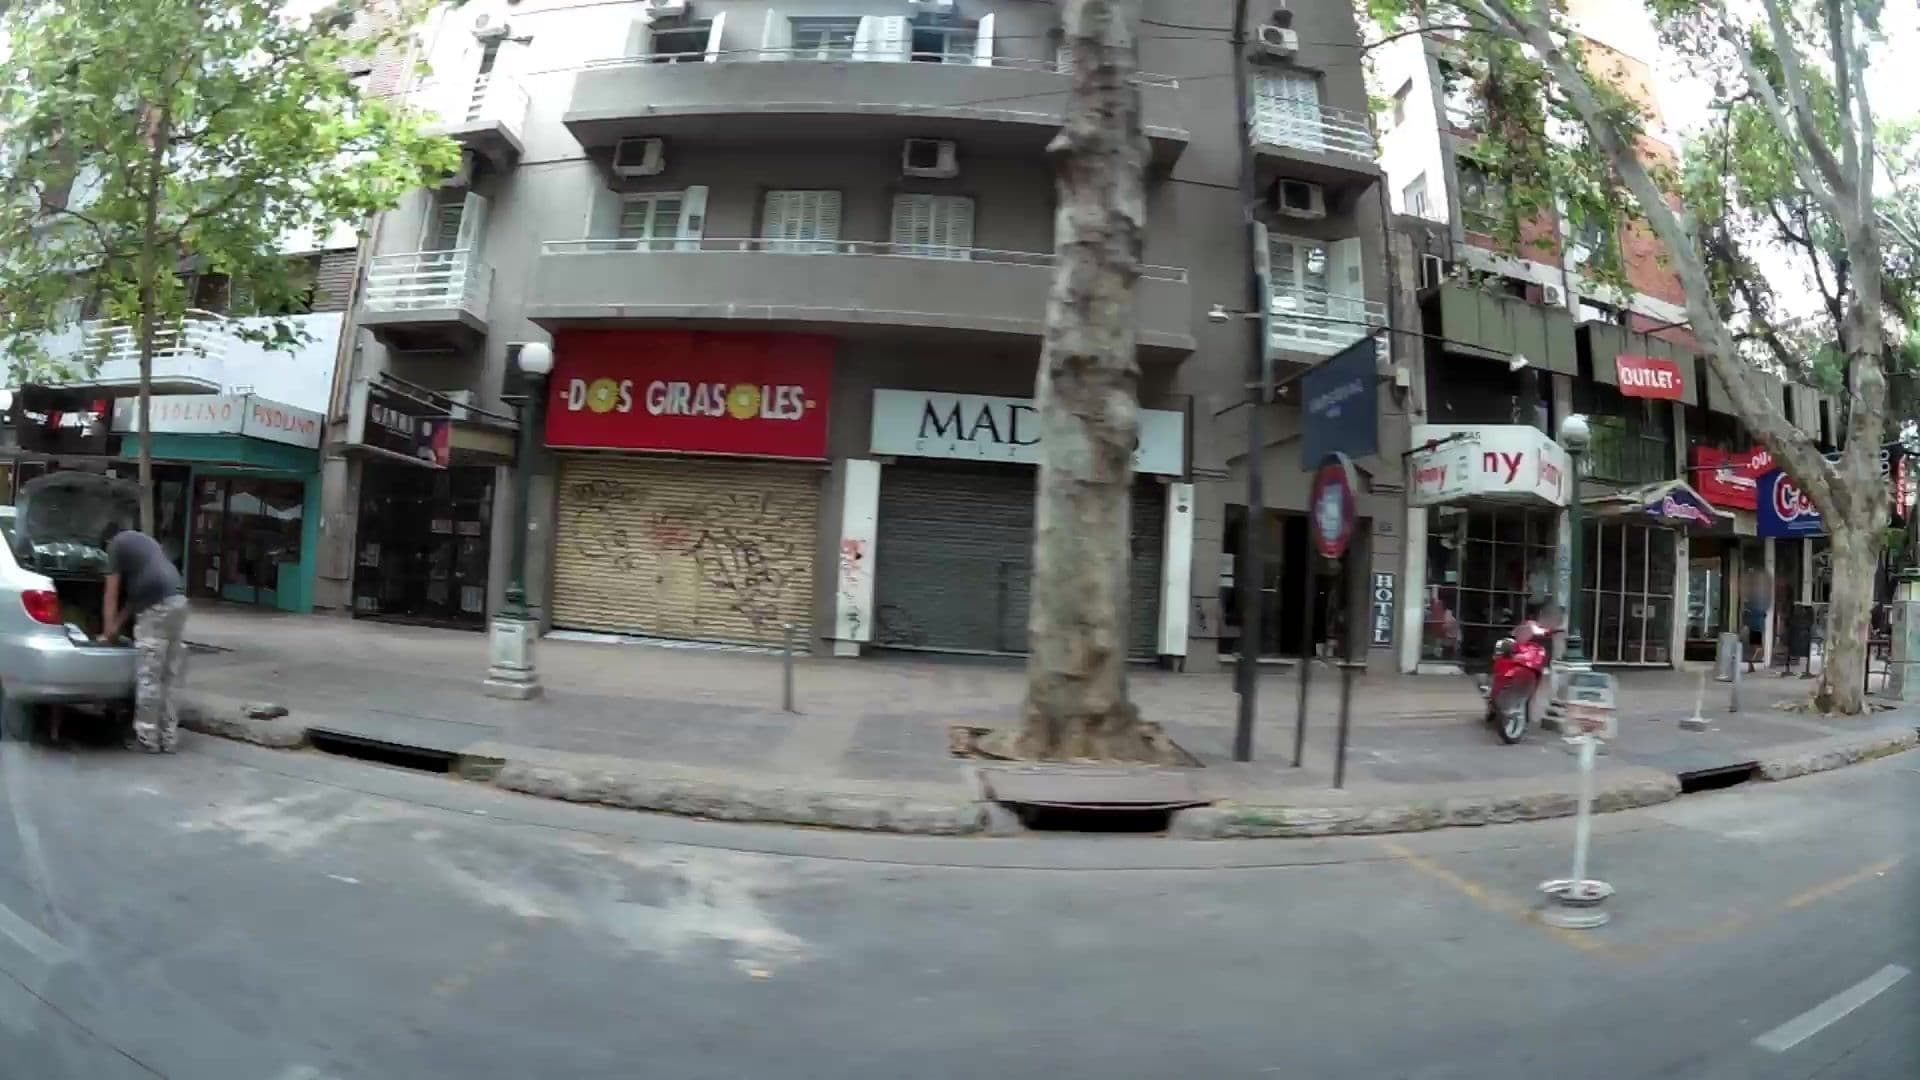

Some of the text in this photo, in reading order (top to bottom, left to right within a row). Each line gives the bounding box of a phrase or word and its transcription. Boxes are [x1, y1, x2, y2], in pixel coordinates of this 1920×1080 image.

[1621, 366, 1673, 389] OUTLET
[918, 399, 1043, 446] MAD
[1374, 574, 1394, 643] HOTEL
